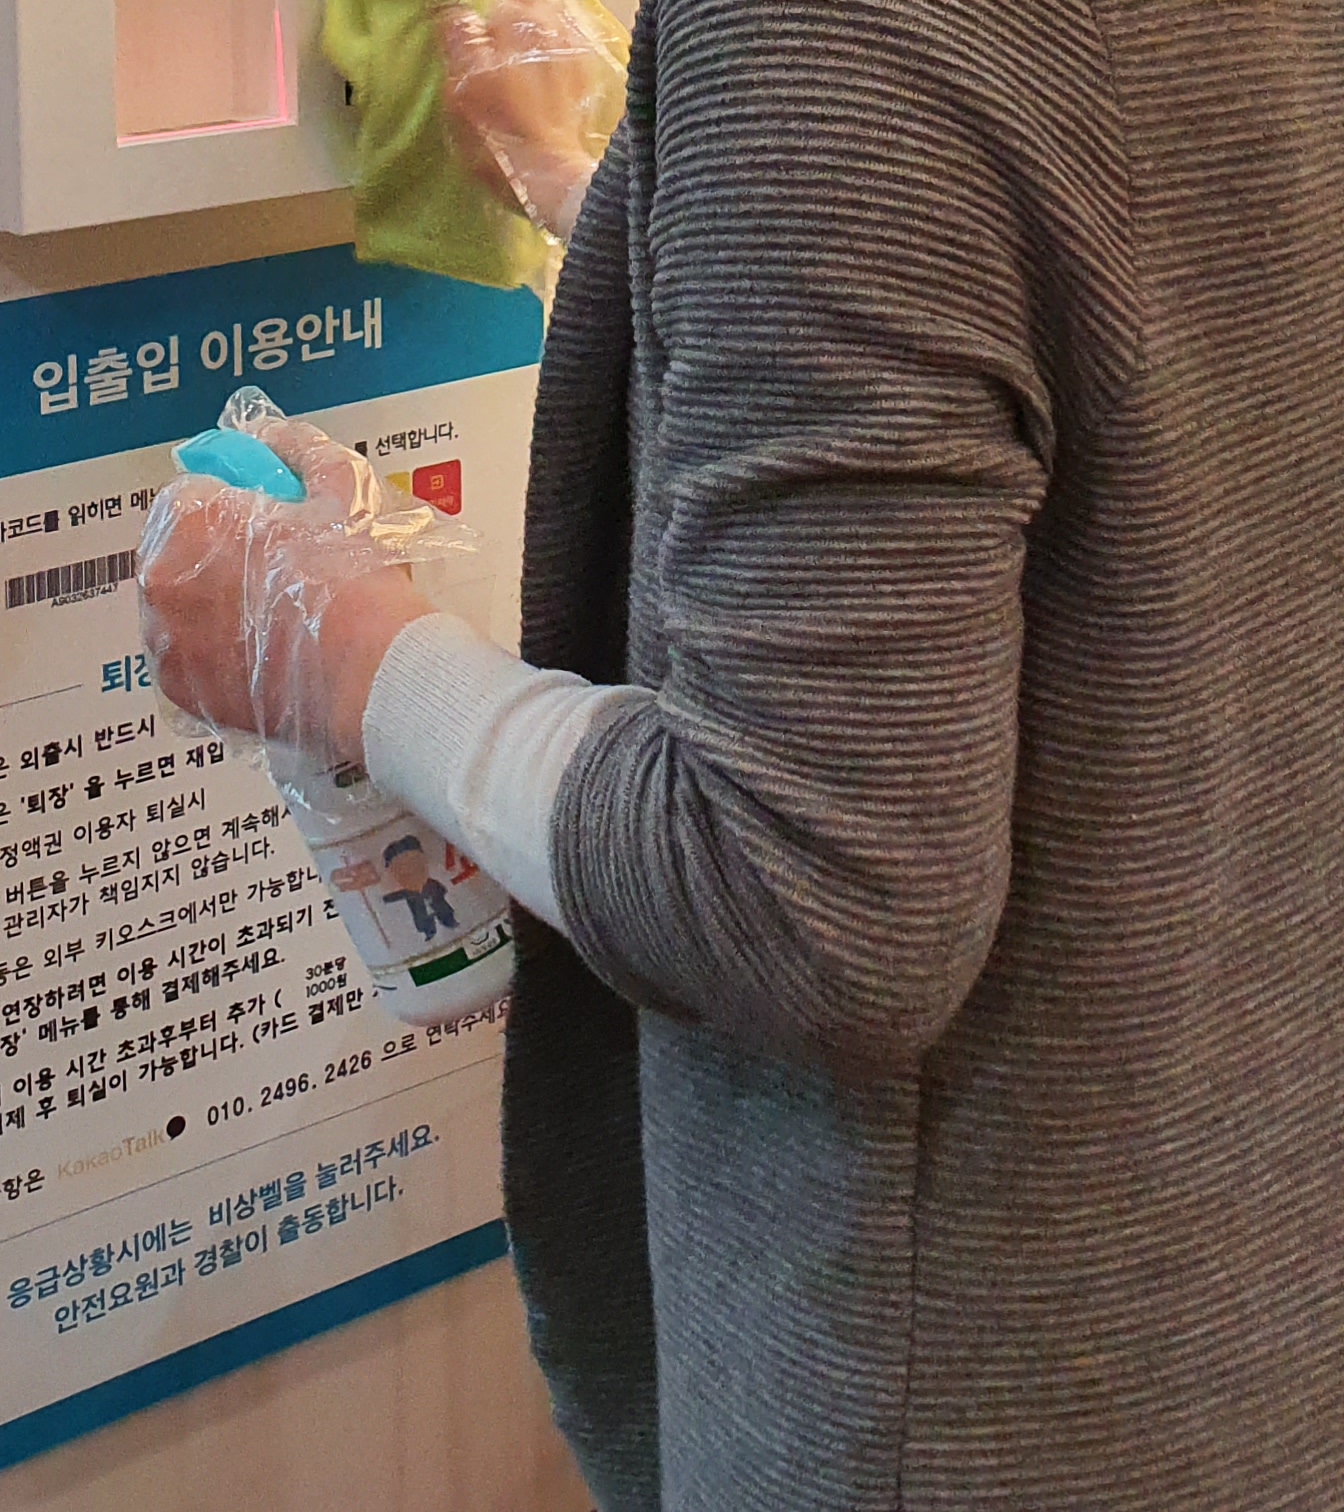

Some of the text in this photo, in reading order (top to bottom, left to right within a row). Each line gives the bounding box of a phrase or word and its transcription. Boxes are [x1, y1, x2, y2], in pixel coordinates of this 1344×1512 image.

[32, 296, 384, 416] 입출입 이용안내
[375, 421, 460, 457] 선택합니다.
[20, 733, 83, 772] 외출시
[95, 714, 155, 752] 반드시
[114, 752, 175, 791] 누르면
[6, 825, 212, 906] 버튼을 누르지 않으면
[73, 808, 136, 845] 이용자
[146, 787, 207, 825] 퇴실시
[4, 892, 90, 940] 관리자가
[100, 864, 180, 905] 책임지지
[191, 836, 276, 881] 않습니다.
[43, 938, 86, 970] 외부
[95, 888, 239, 952] 키오스크에서만
[2, 972, 106, 1026] 연장하려면
[117, 957, 158, 986] 이용
[167, 933, 225, 970] 시간이
[236, 904, 312, 949] 초과되기
[38, 948, 285, 1043] 메뉴를 통해 결제해주세요.
[13, 1067, 56, 1097] 이용
[66, 1048, 107, 1078] 시간
[116, 1010, 218, 1063] 초과후부터
[227, 993, 266, 1025] 추가
[36, 1095, 57, 1120] 후
[139, 1031, 245, 1082] 가능합니다.
[253, 1012, 300, 1045] (카드
[308, 988, 365, 1025] 결제만
[57, 1129, 165, 1178] KakaoTalk
[325, 1050, 372, 1084] 2426
[380, 1033, 418, 1062] 으로
[7, 1124, 440, 1309] 응급상황시에는 비상벨을 눌러주세요.
[54, 1175, 404, 1334] 안전요원과 경찰이 출동합니다.
